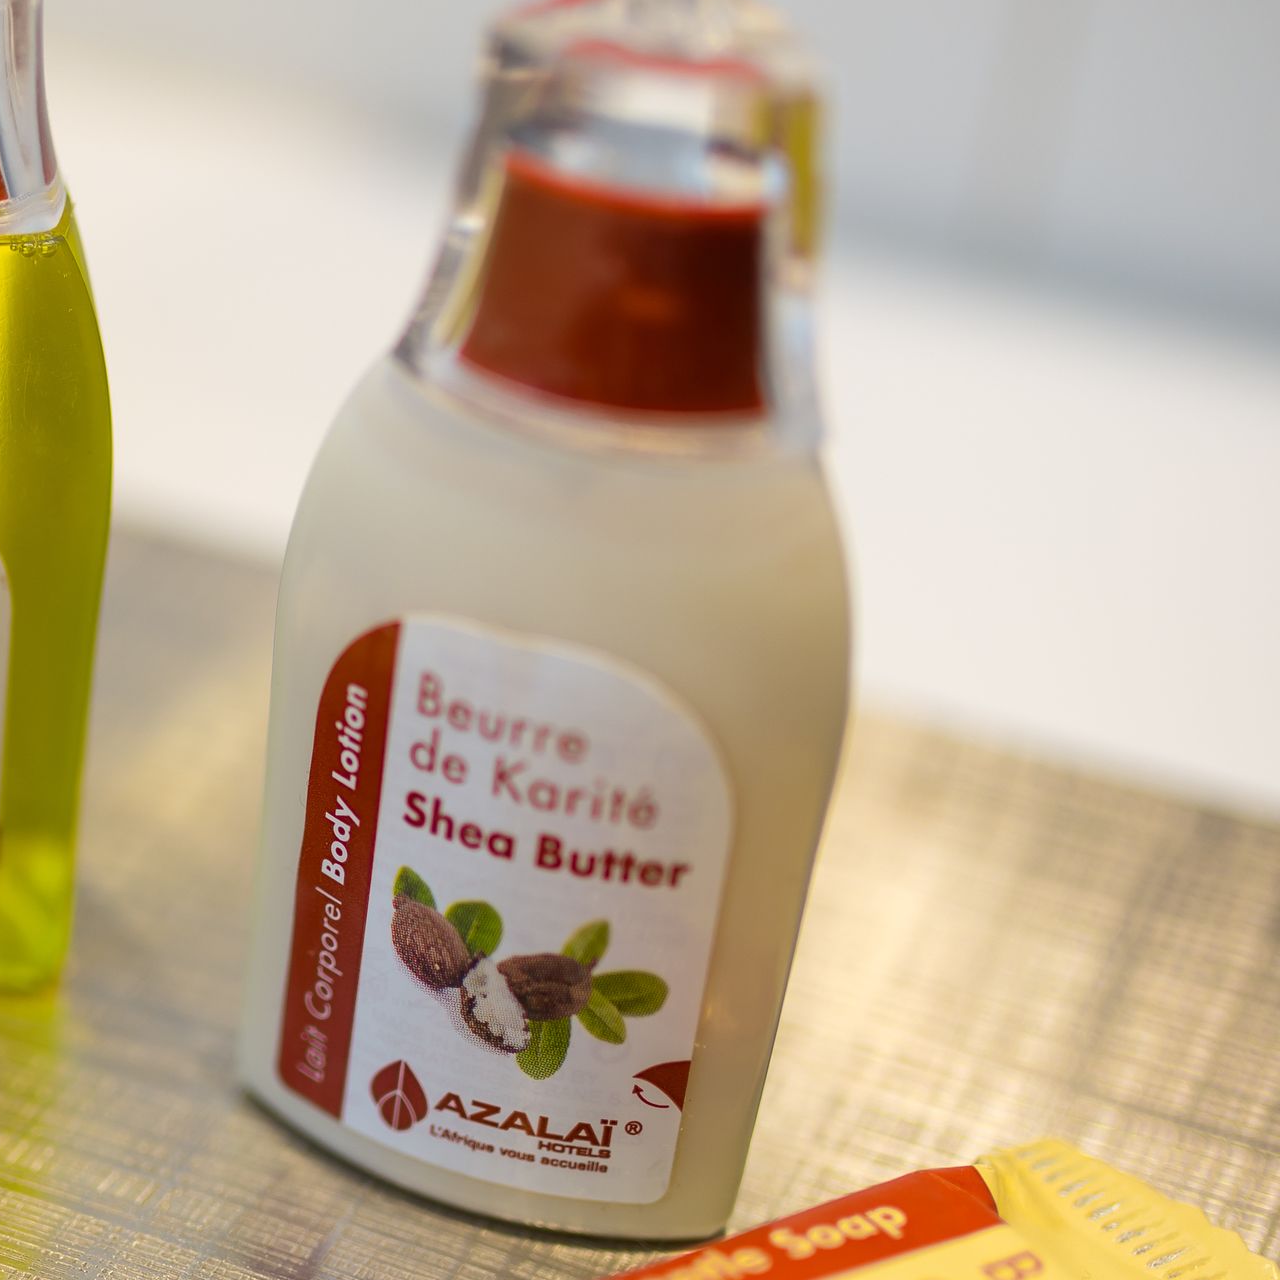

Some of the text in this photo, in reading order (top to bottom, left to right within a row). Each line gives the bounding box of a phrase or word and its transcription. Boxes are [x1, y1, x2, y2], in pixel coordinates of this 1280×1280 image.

[332, 683, 369, 791] Lotion
[417, 670, 590, 765] Beurre
[409, 726, 658, 830] de Karité
[321, 796, 361, 886] Body
[403, 789, 692, 889] Shea Butter
[500, 1147, 535, 1163] vous
[540, 1154, 608, 1174] accueille
[537, 1139, 611, 1160] HOTELS
[769, 1206, 906, 1260] Soap
